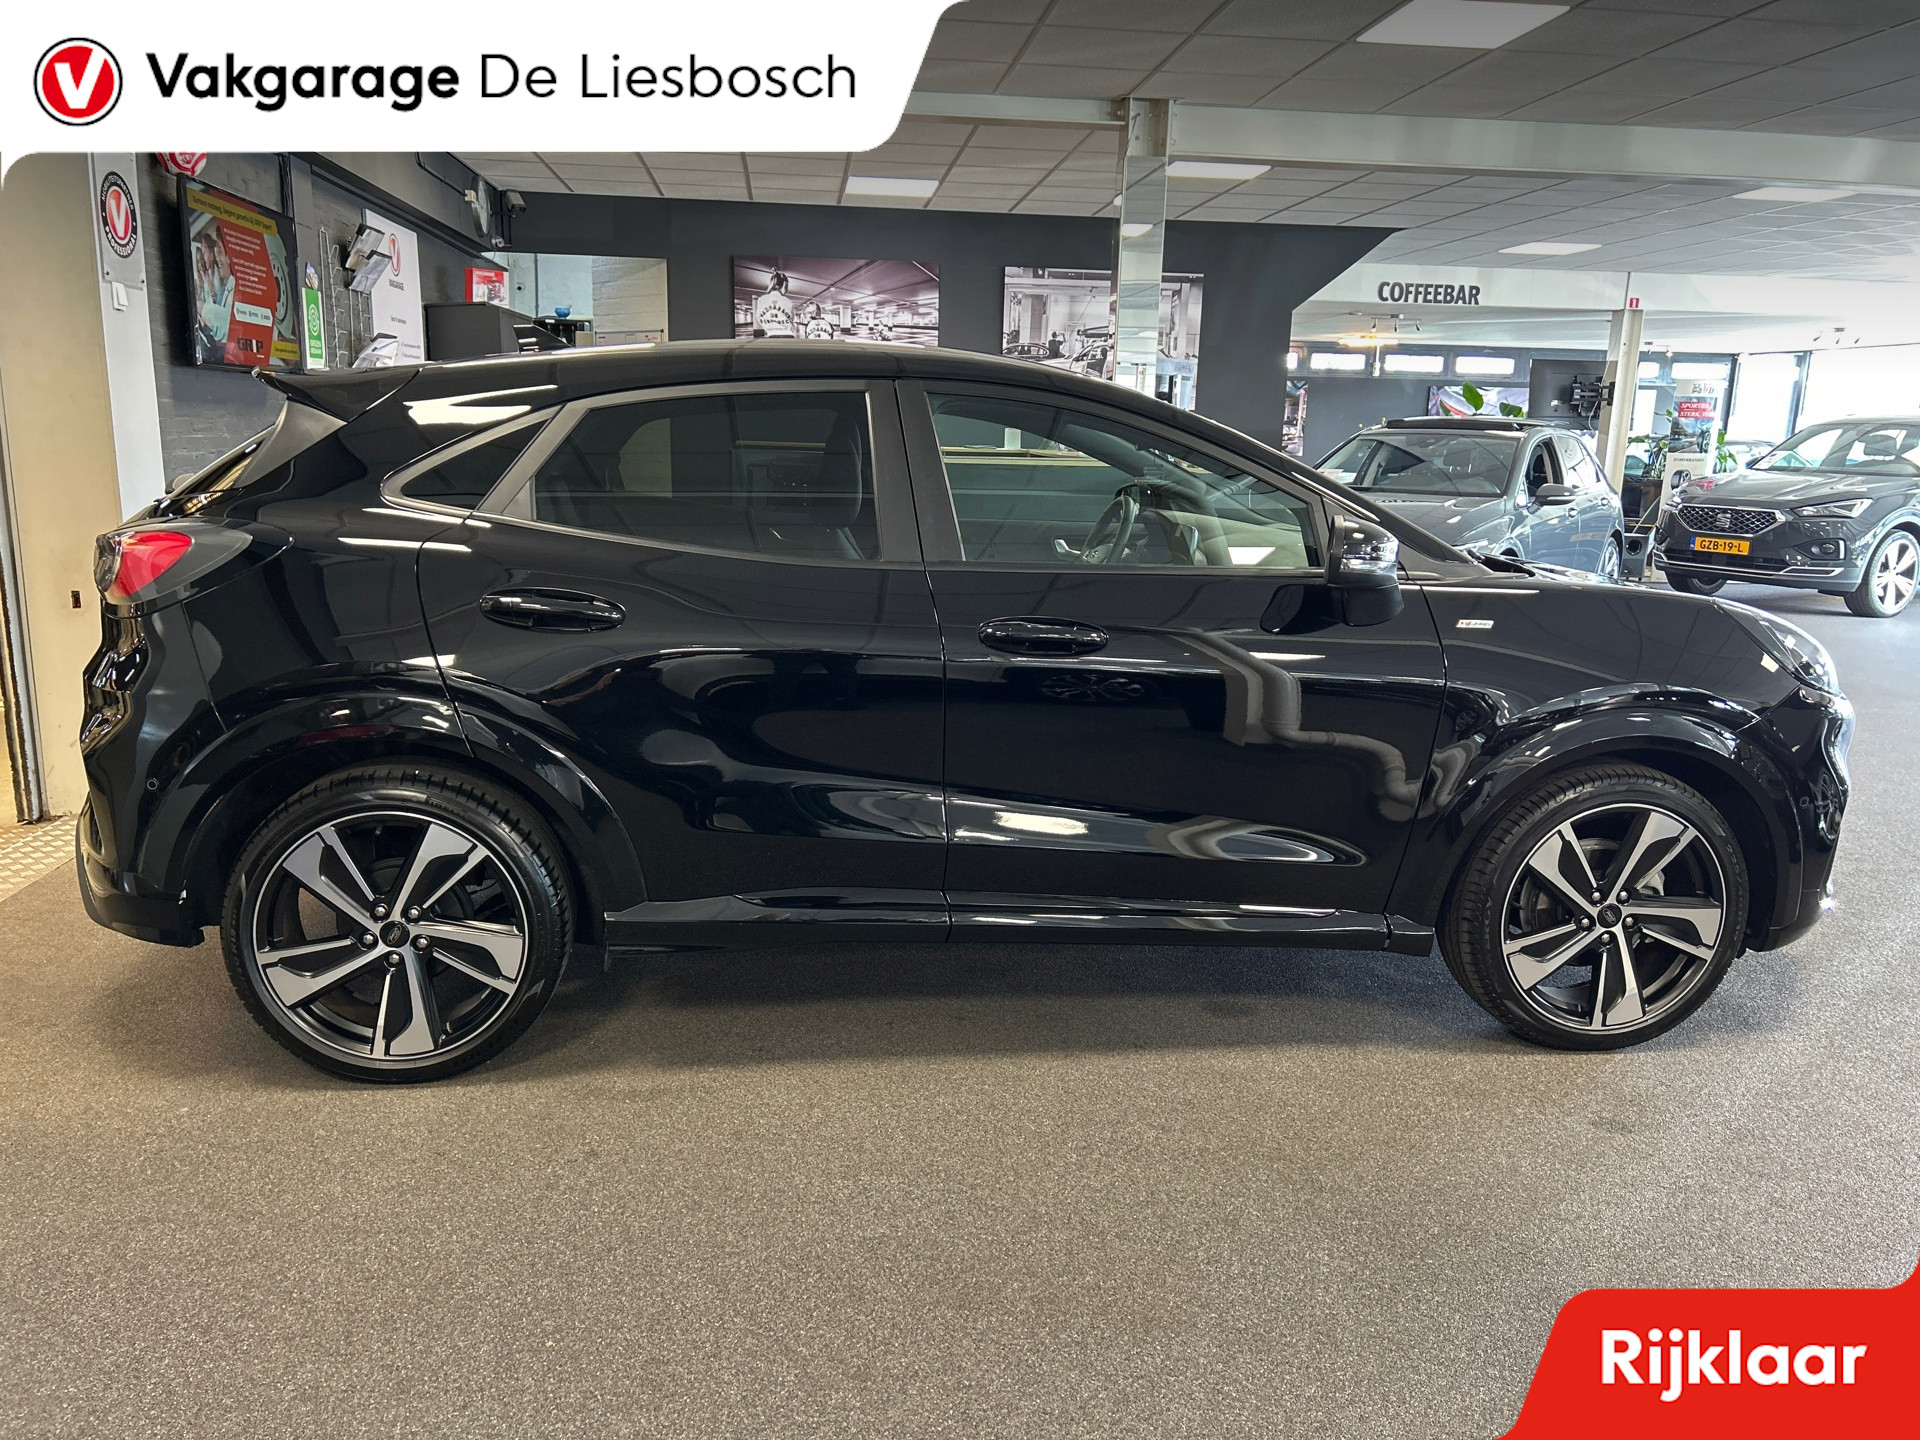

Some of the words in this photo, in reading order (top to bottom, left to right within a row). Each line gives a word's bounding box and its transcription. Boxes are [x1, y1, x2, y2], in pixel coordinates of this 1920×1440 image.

[105, 226, 137, 257] PROFESSIONAL
[1378, 281, 1480, 305] COFFEEBAR
[237, 338, 264, 353] GRIP
[1699, 539, 1744, 553] GZB-19-L
